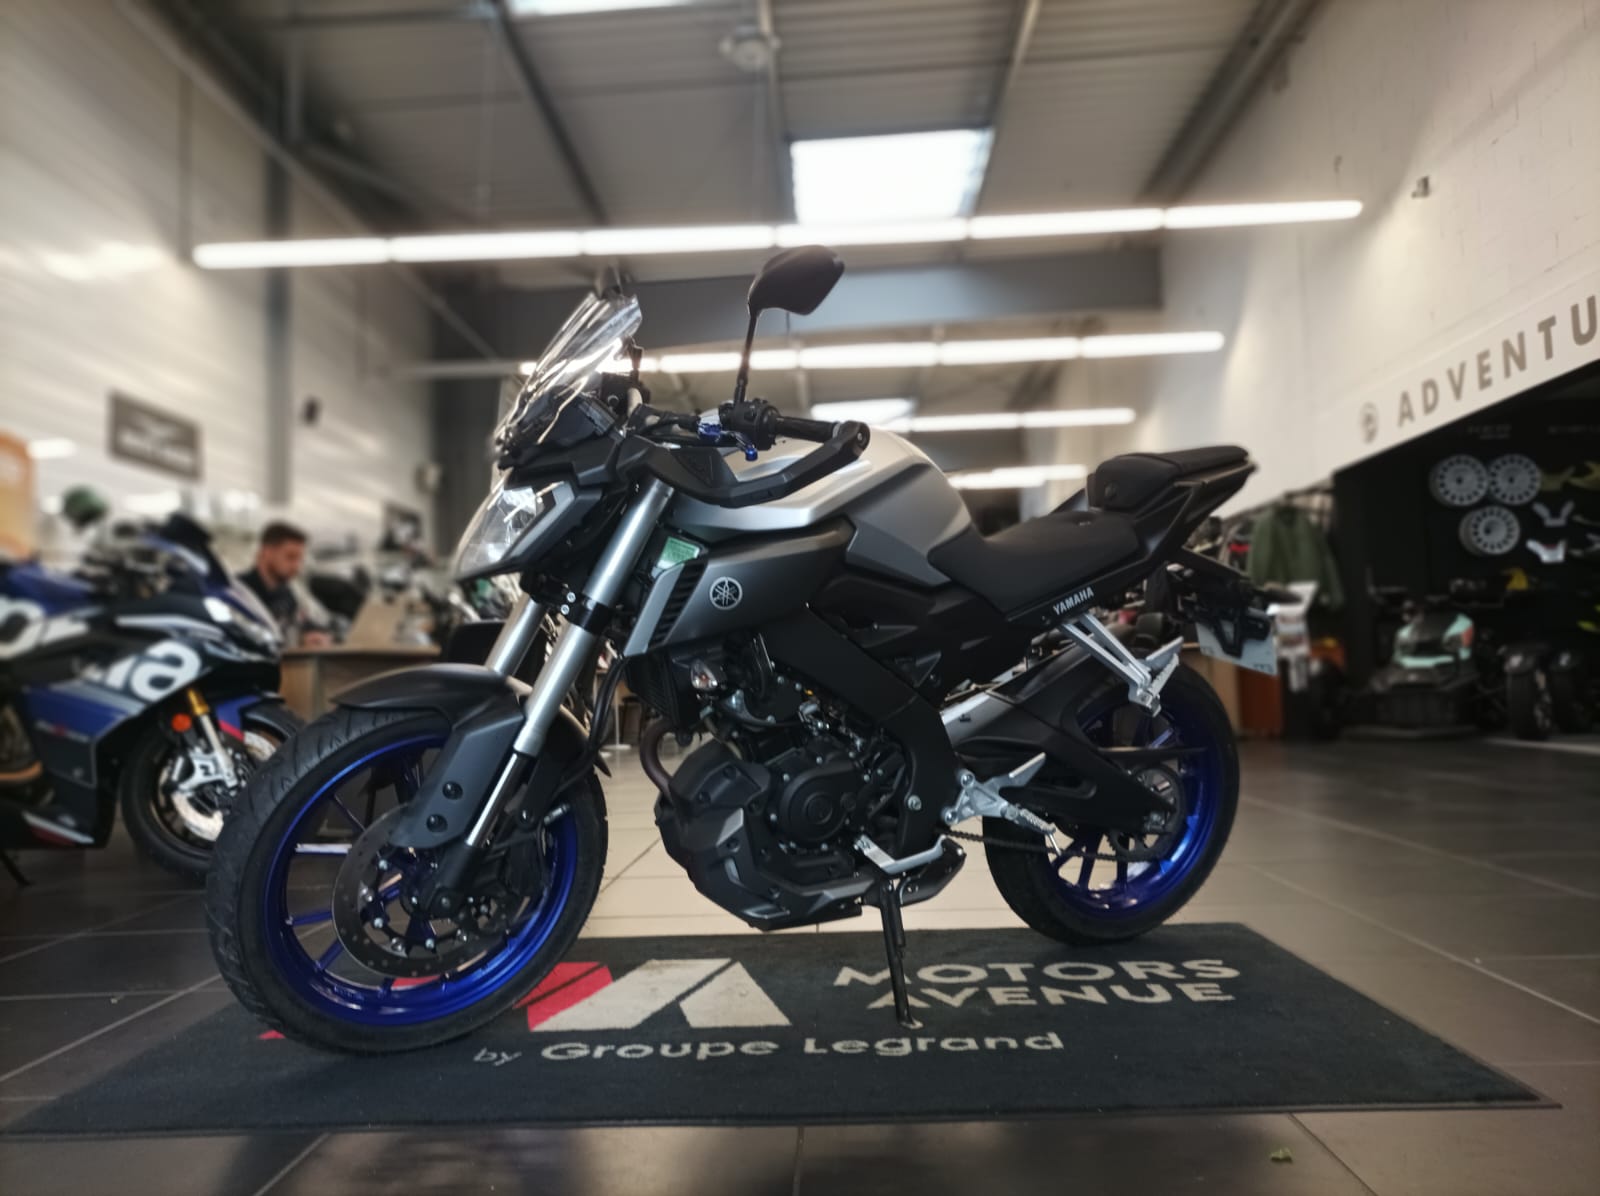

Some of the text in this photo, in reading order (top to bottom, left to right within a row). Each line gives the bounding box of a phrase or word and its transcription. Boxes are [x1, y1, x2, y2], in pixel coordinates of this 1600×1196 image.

[1397, 294, 1598, 427] ADVENTU
[1053, 586, 1094, 615] YAMAHA
[834, 960, 1240, 986] MOTORS
[867, 983, 1236, 1009] AVENUE
[473, 1032, 1064, 1066] by Groupe Legrand
